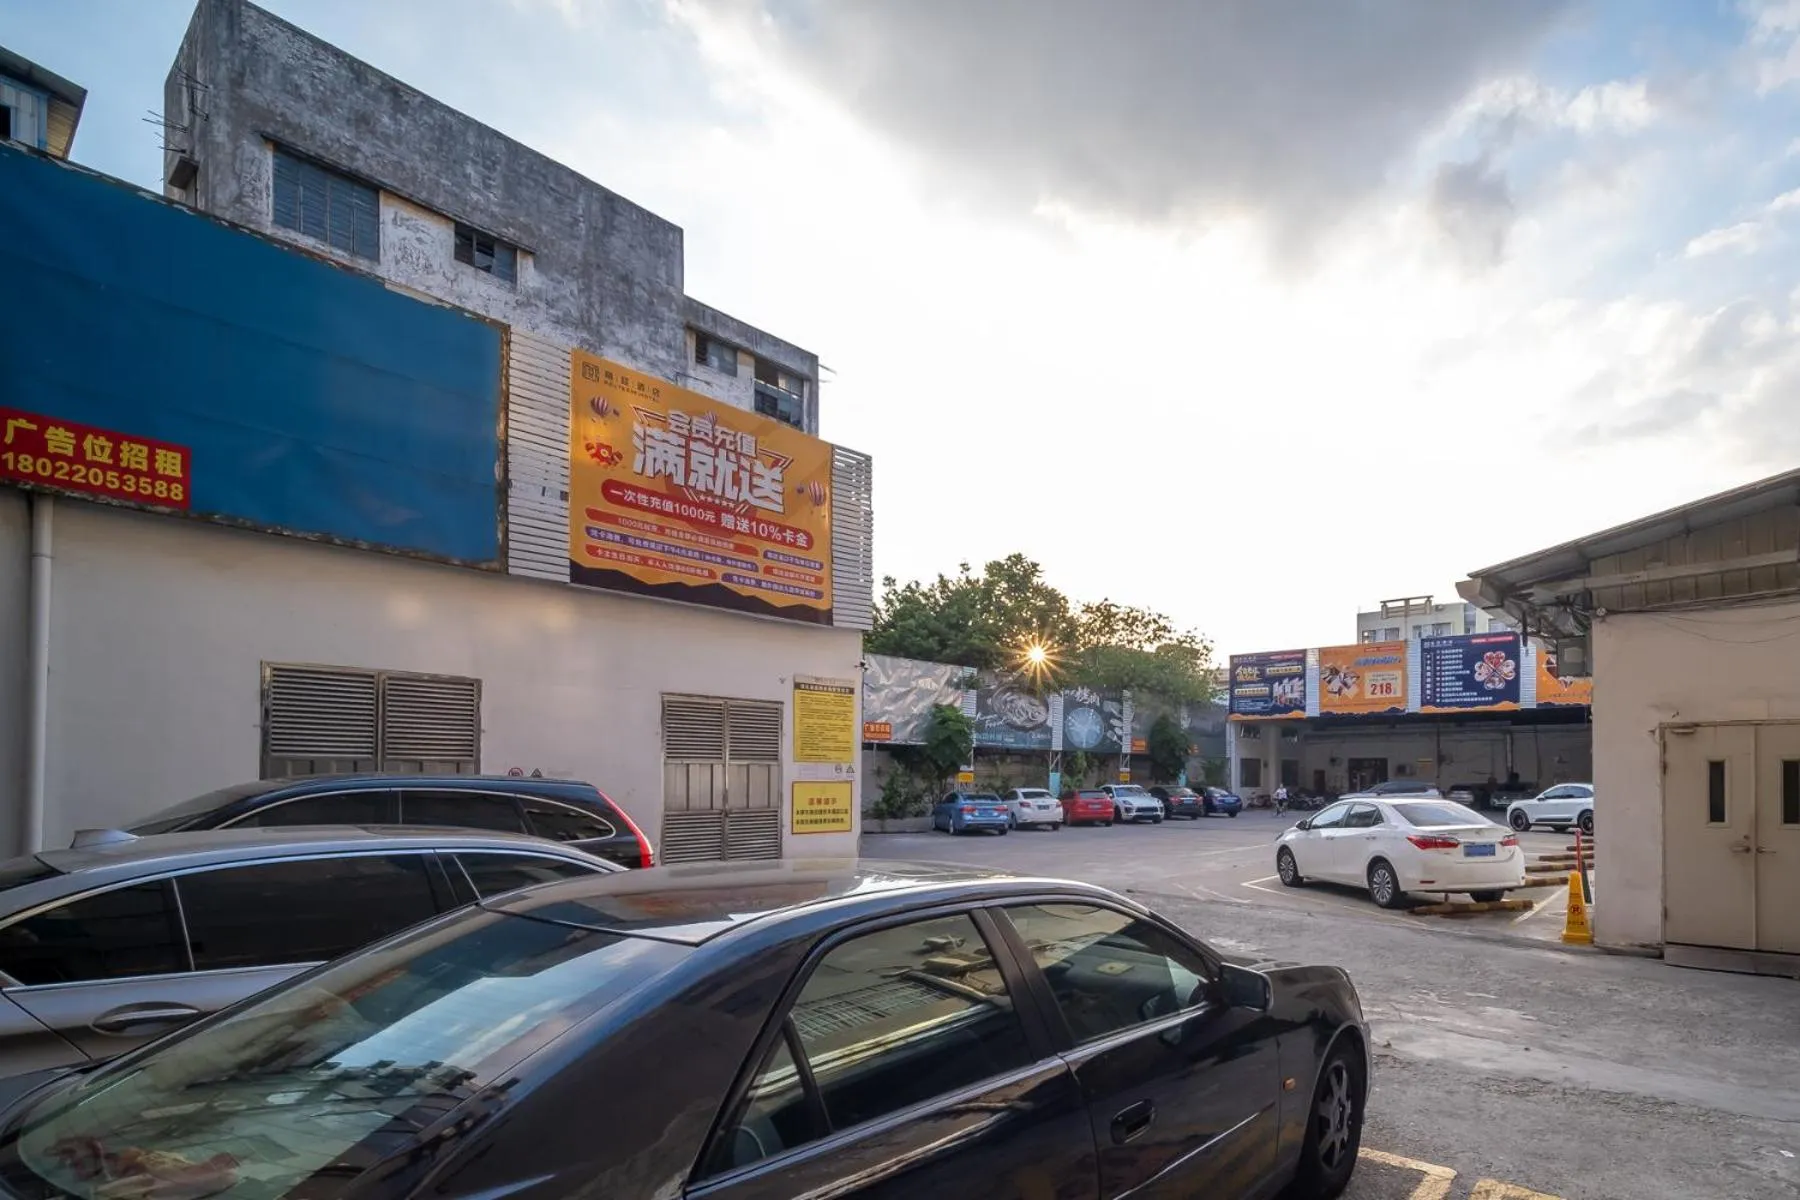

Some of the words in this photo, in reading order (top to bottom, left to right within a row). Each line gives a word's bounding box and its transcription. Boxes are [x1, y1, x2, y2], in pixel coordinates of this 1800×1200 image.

[5, 418, 183, 478] 广告位招租
[668, 410, 757, 458] 会员充值
[1, 451, 184, 500] 18022053588
[633, 421, 785, 514] 满就送
[610, 488, 717, 524] 一次性充值1000元
[721, 512, 809, 548] 赠送10%卡金
[1370, 682, 1393, 696] 218
